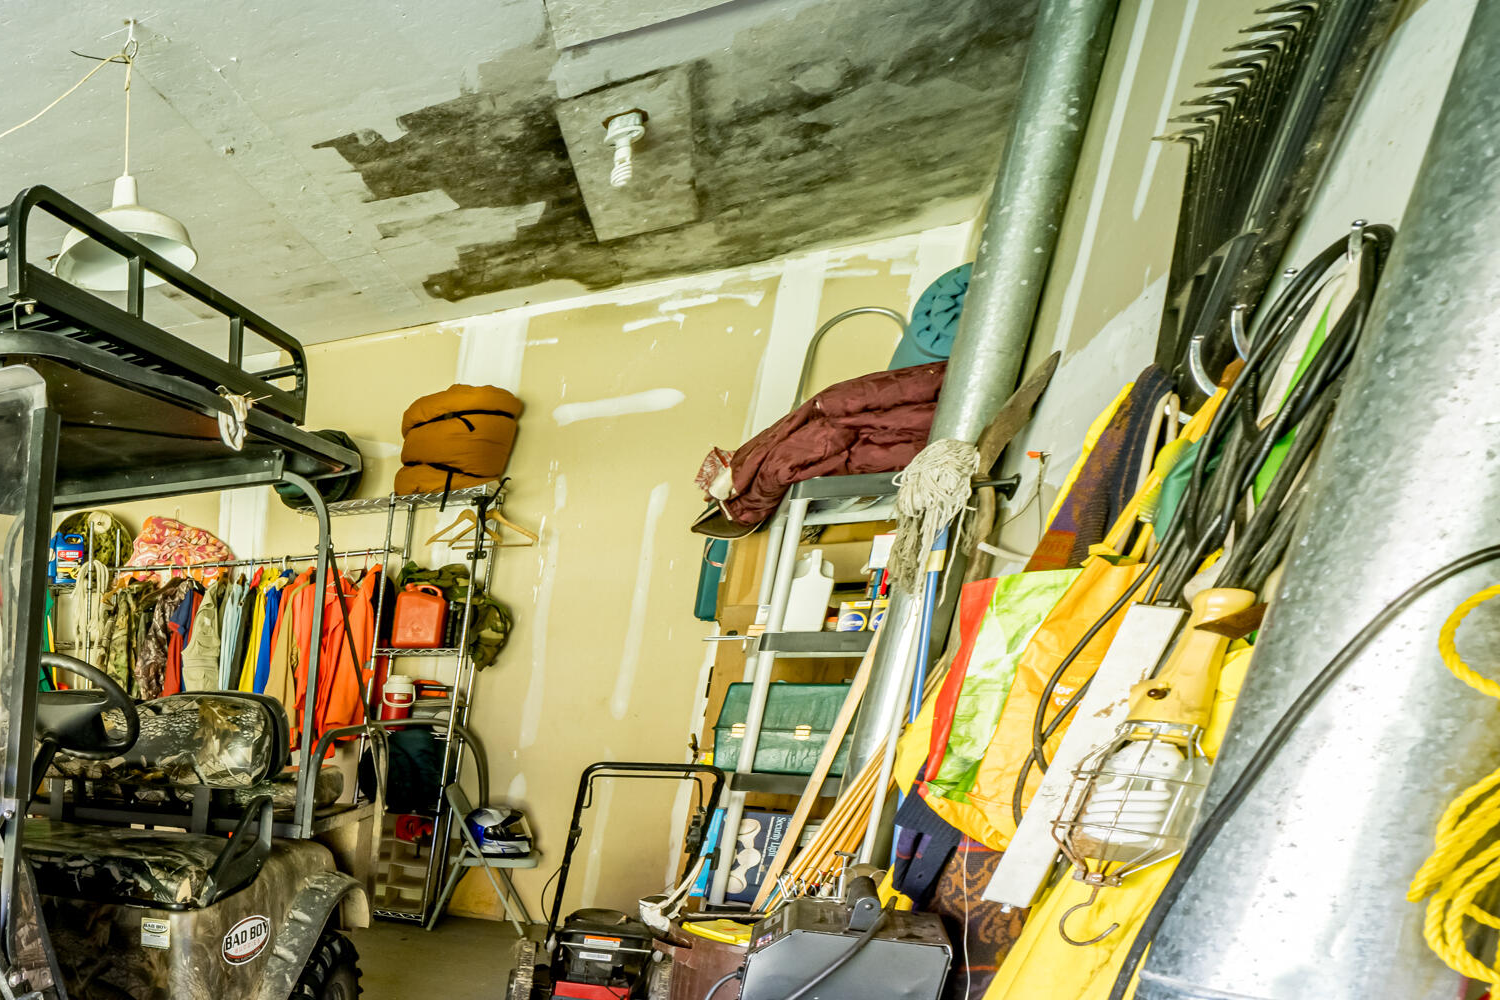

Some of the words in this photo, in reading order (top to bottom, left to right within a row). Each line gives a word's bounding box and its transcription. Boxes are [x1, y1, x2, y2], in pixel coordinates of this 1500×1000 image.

[770, 816, 787, 841] Security
[225, 930, 248, 951] BAD
[250, 922, 268, 940] BOY
